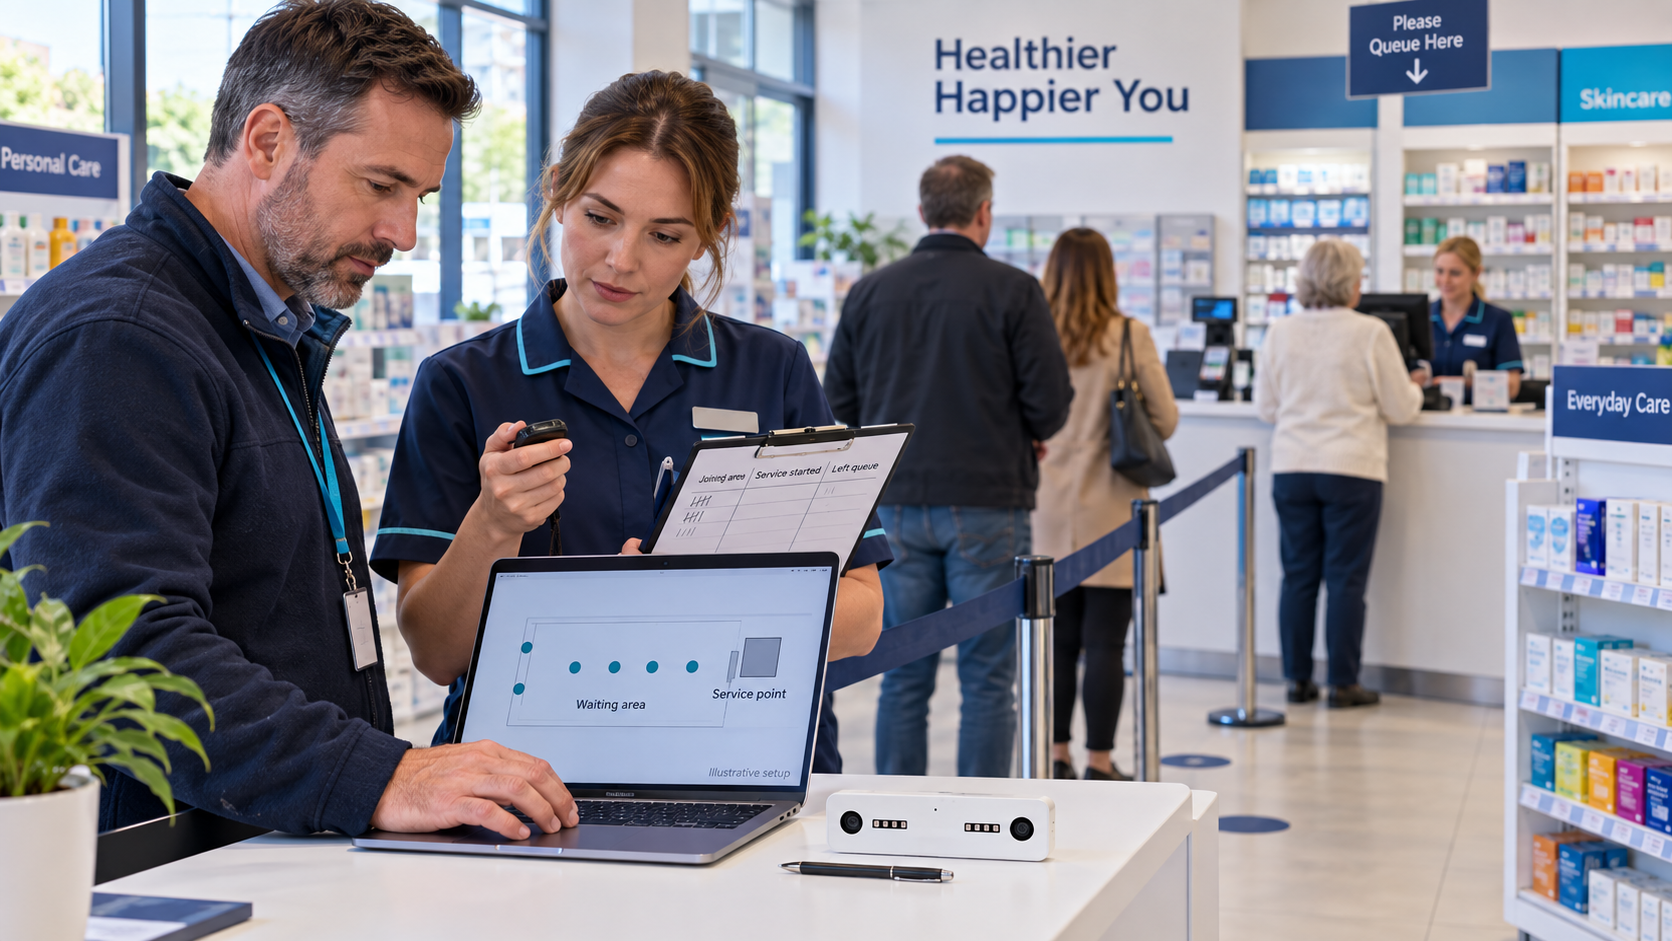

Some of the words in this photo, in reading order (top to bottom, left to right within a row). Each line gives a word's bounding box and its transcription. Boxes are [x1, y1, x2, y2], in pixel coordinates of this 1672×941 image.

[1393, 14, 1442, 31] Please
[935, 36, 1117, 70] Healthier
[1369, 36, 1420, 57] Queue
[1424, 33, 1464, 50] Here
[935, 78, 1100, 122] Happier
[1113, 79, 1189, 112] You
[1579, 86, 1672, 111] Skincare
[1, 146, 66, 174] Personal
[68, 154, 102, 178] Care
[1567, 389, 1632, 418] Everyday
[1635, 391, 1671, 414] Care
[755, 470, 788, 480] Service
[789, 466, 822, 477] started
[832, 464, 850, 473] Left
[851, 461, 879, 472] queue
[699, 474, 727, 484] Joining
[712, 688, 754, 699] Service
[756, 688, 787, 701] point
[576, 699, 618, 712] Waiting
[621, 701, 646, 710] area
[708, 767, 760, 777] Illustrative
[762, 769, 791, 780] setup
